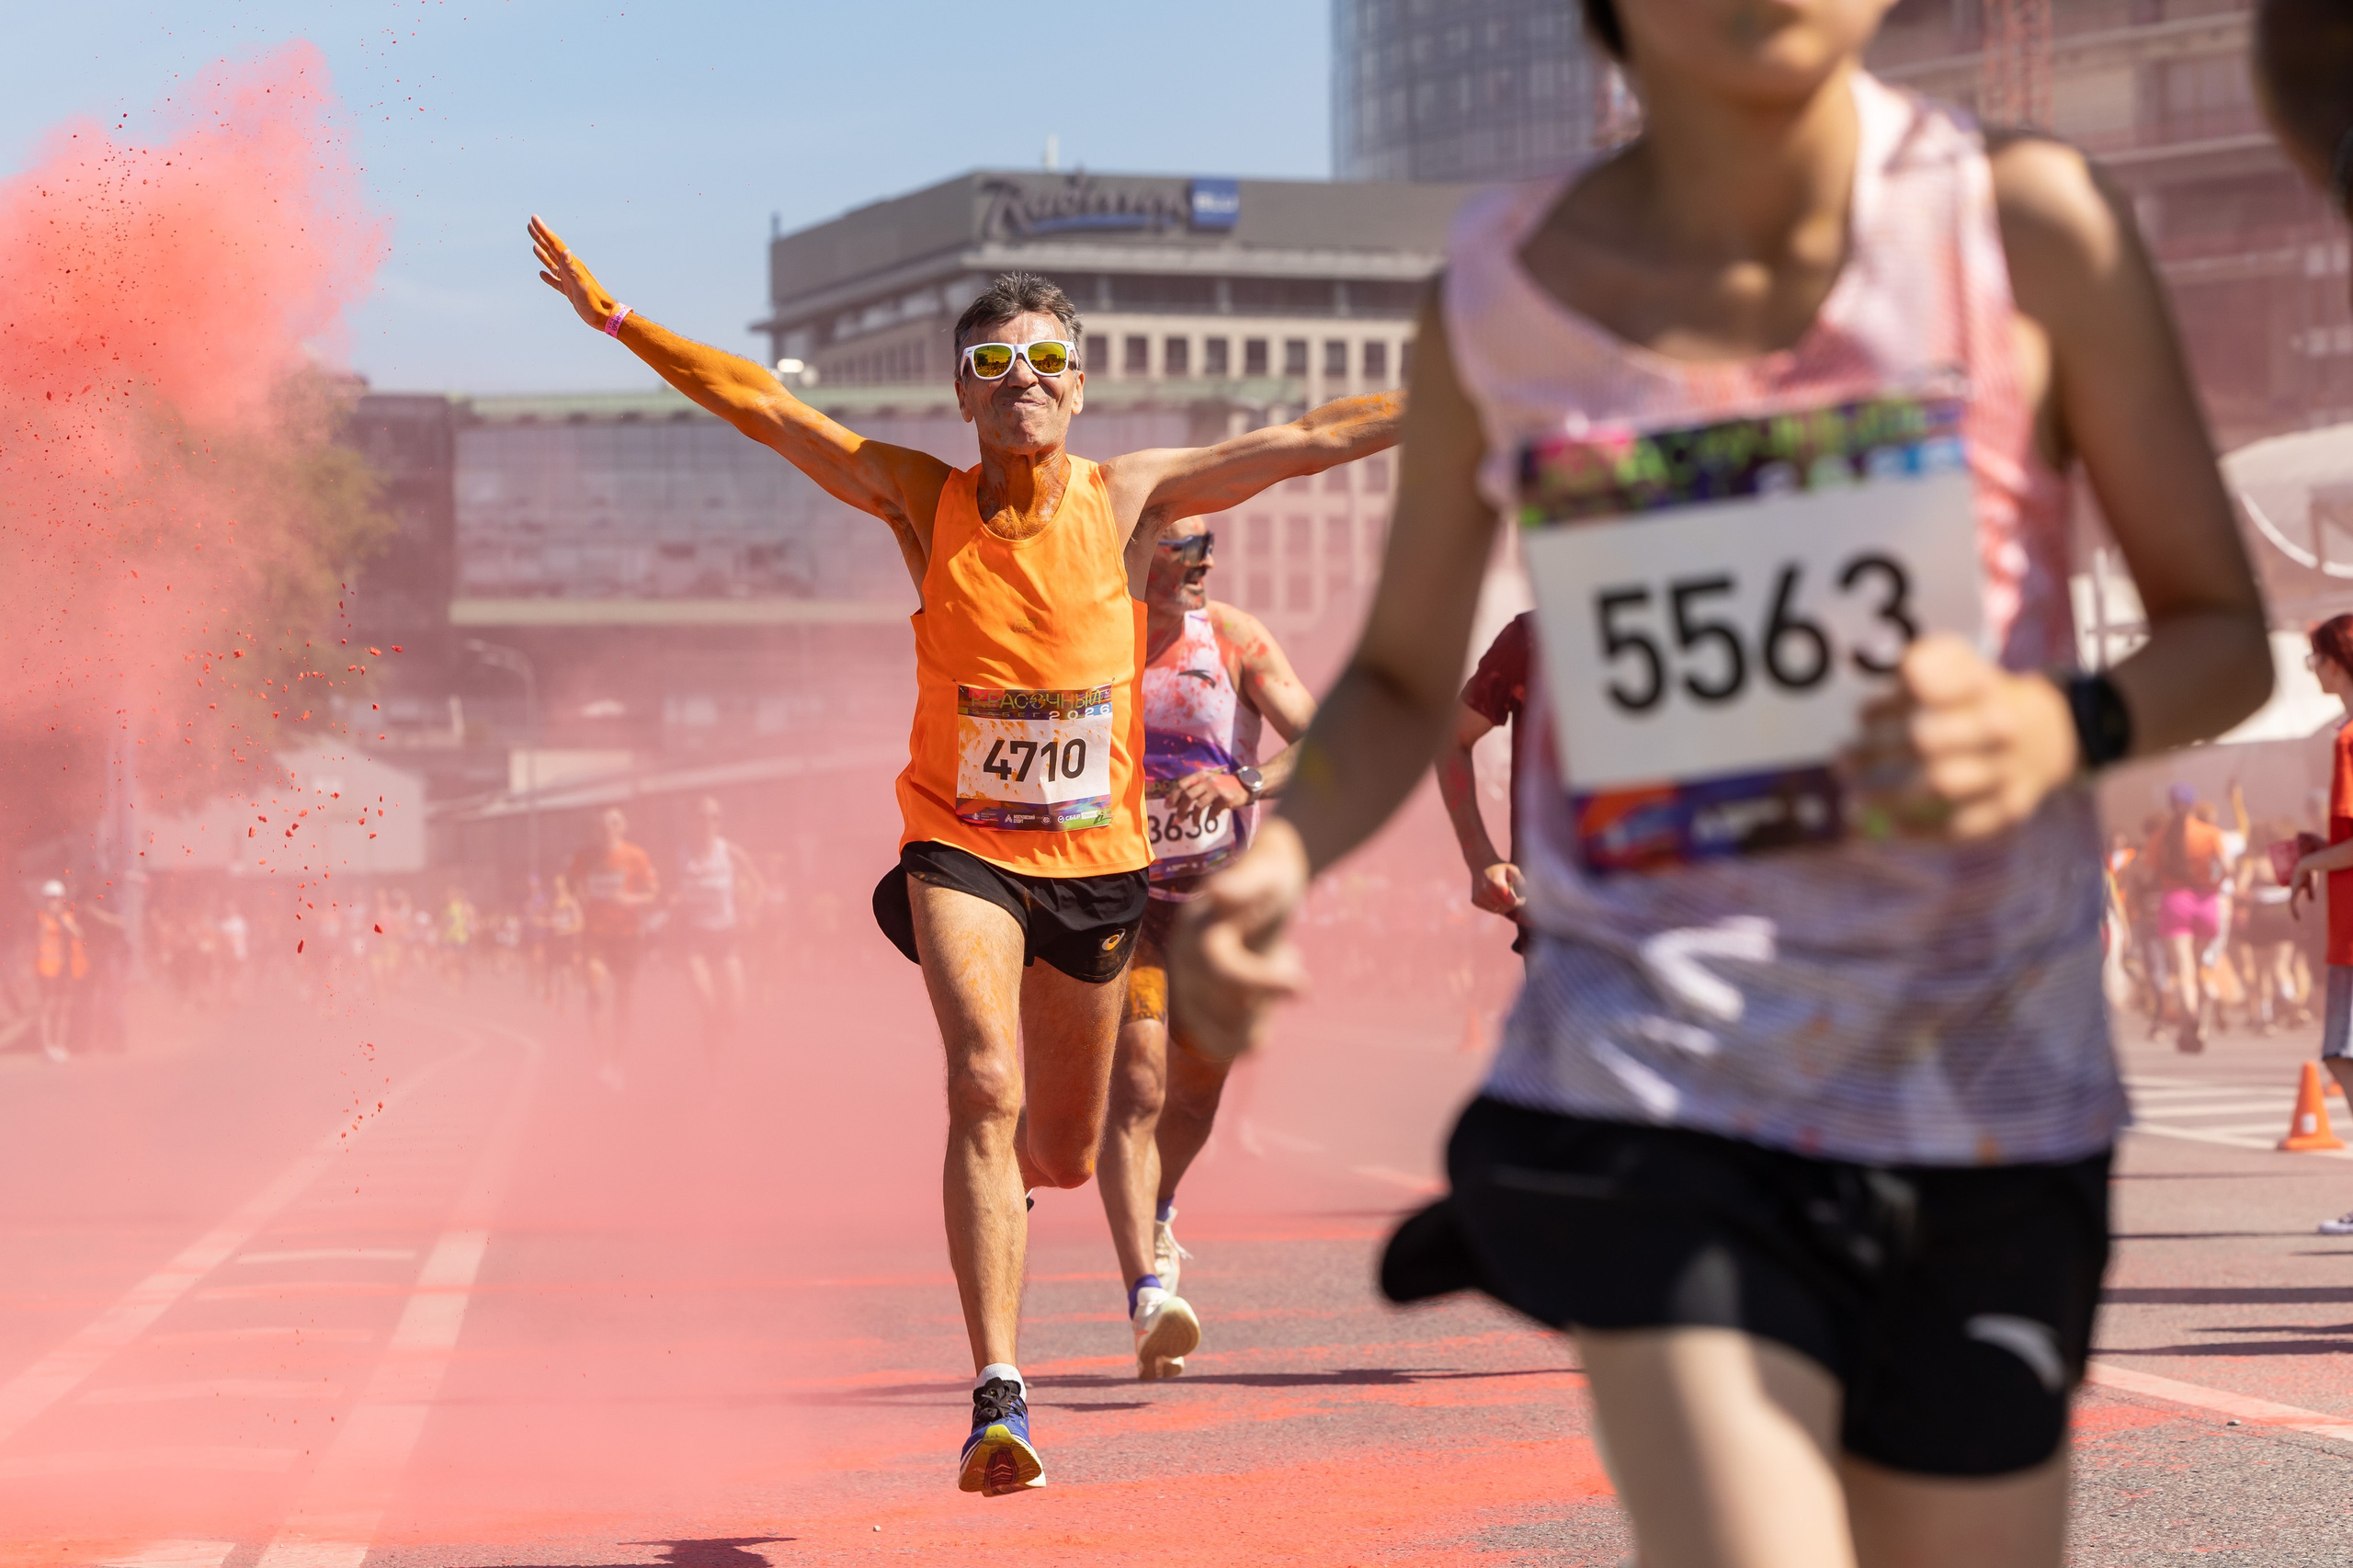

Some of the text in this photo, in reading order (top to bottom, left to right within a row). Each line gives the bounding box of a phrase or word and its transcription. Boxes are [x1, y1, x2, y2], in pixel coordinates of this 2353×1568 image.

[1596, 553, 1919, 713] 5563
[972, 689, 1102, 710] КРАСОЧНЫЙ
[1049, 704, 1110, 721] 2026
[983, 738, 1086, 782] 4710
